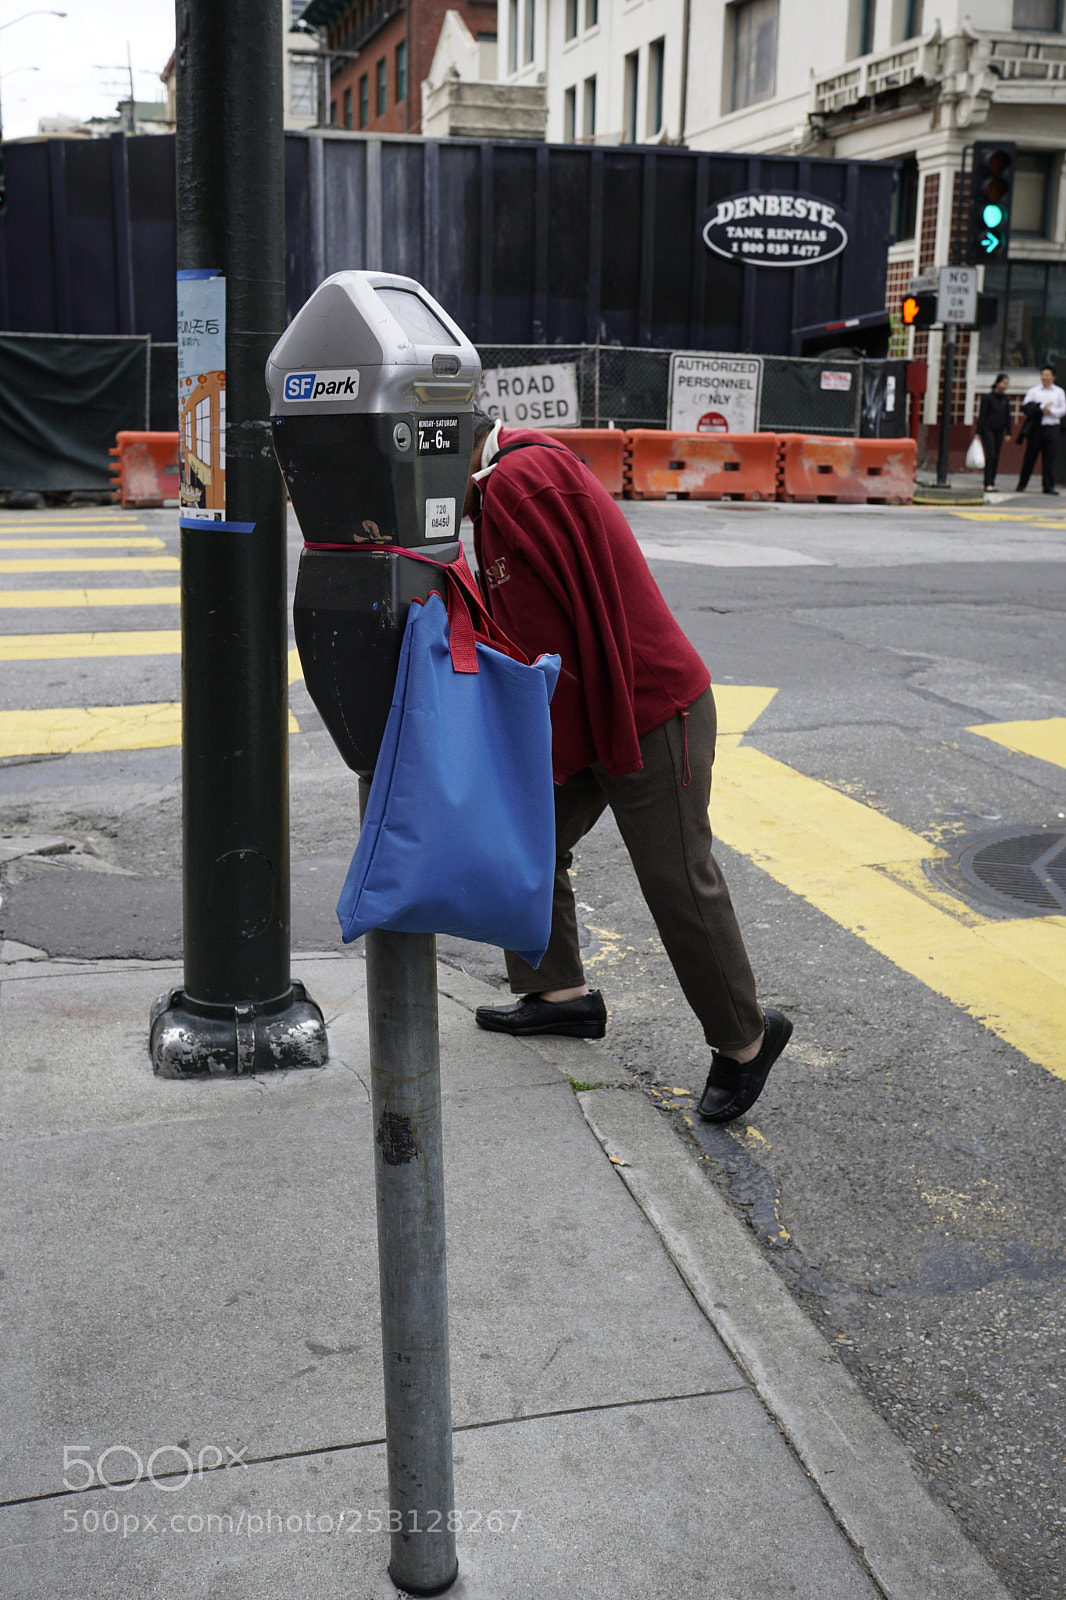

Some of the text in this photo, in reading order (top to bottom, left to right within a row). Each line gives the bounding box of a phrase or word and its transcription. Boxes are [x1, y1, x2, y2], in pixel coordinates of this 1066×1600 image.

[716, 195, 836, 229] DENBESTE
[726, 226, 828, 242] TANK RENTALS
[731, 242, 739, 253] 1
[741, 243, 765, 254] 800
[792, 245, 822, 257] 1477
[949, 272, 969, 284] NO
[946, 285, 970, 295] TURN
[949, 297, 964, 307] ON
[947, 309, 966, 319] RED
[678, 360, 757, 374] AUTHORIZED
[288, 376, 357, 400] SFpark
[497, 375, 555, 397] ROAD
[678, 376, 754, 390] PERSONNEL
[488, 400, 569, 422] CLOSED
[436, 504, 447, 515] 720
